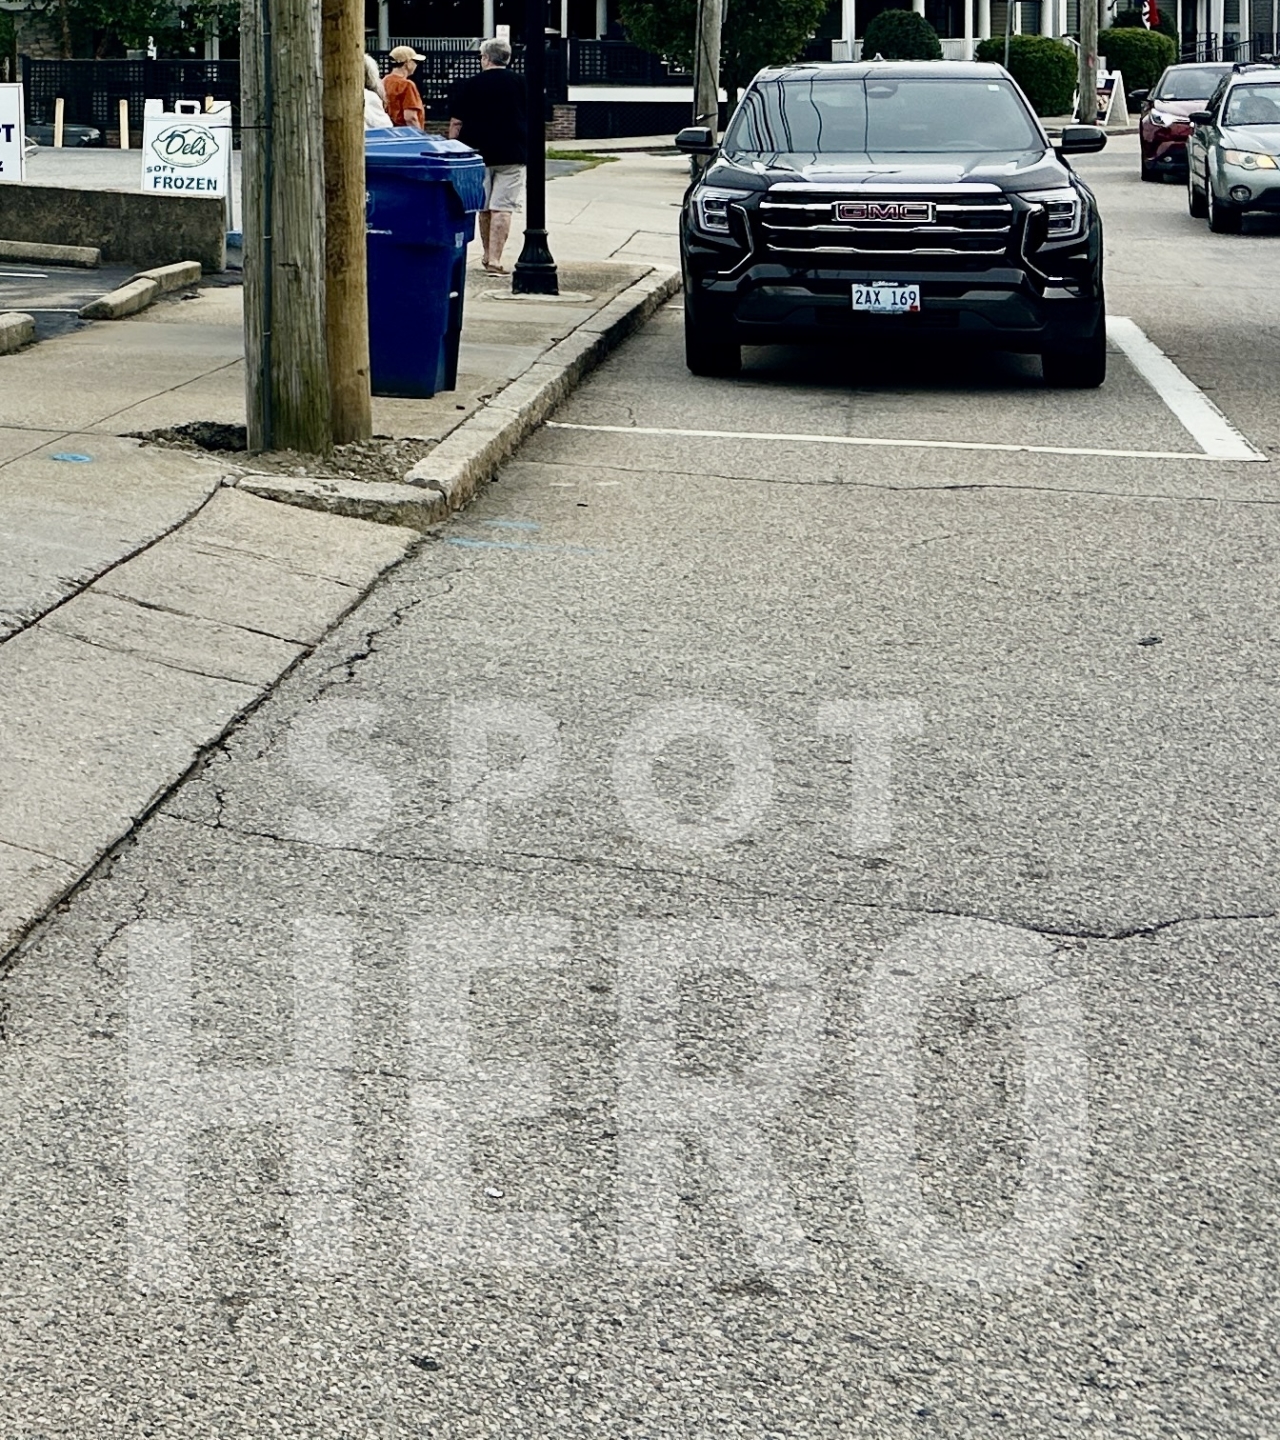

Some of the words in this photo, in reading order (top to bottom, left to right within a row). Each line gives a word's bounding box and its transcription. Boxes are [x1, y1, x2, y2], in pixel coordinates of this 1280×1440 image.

[146, 164, 176, 174] SOFT
[153, 176, 218, 191] FROZEN
[840, 204, 928, 220] GMC
[854, 289, 881, 305] 2AX
[890, 291, 917, 306] 169
